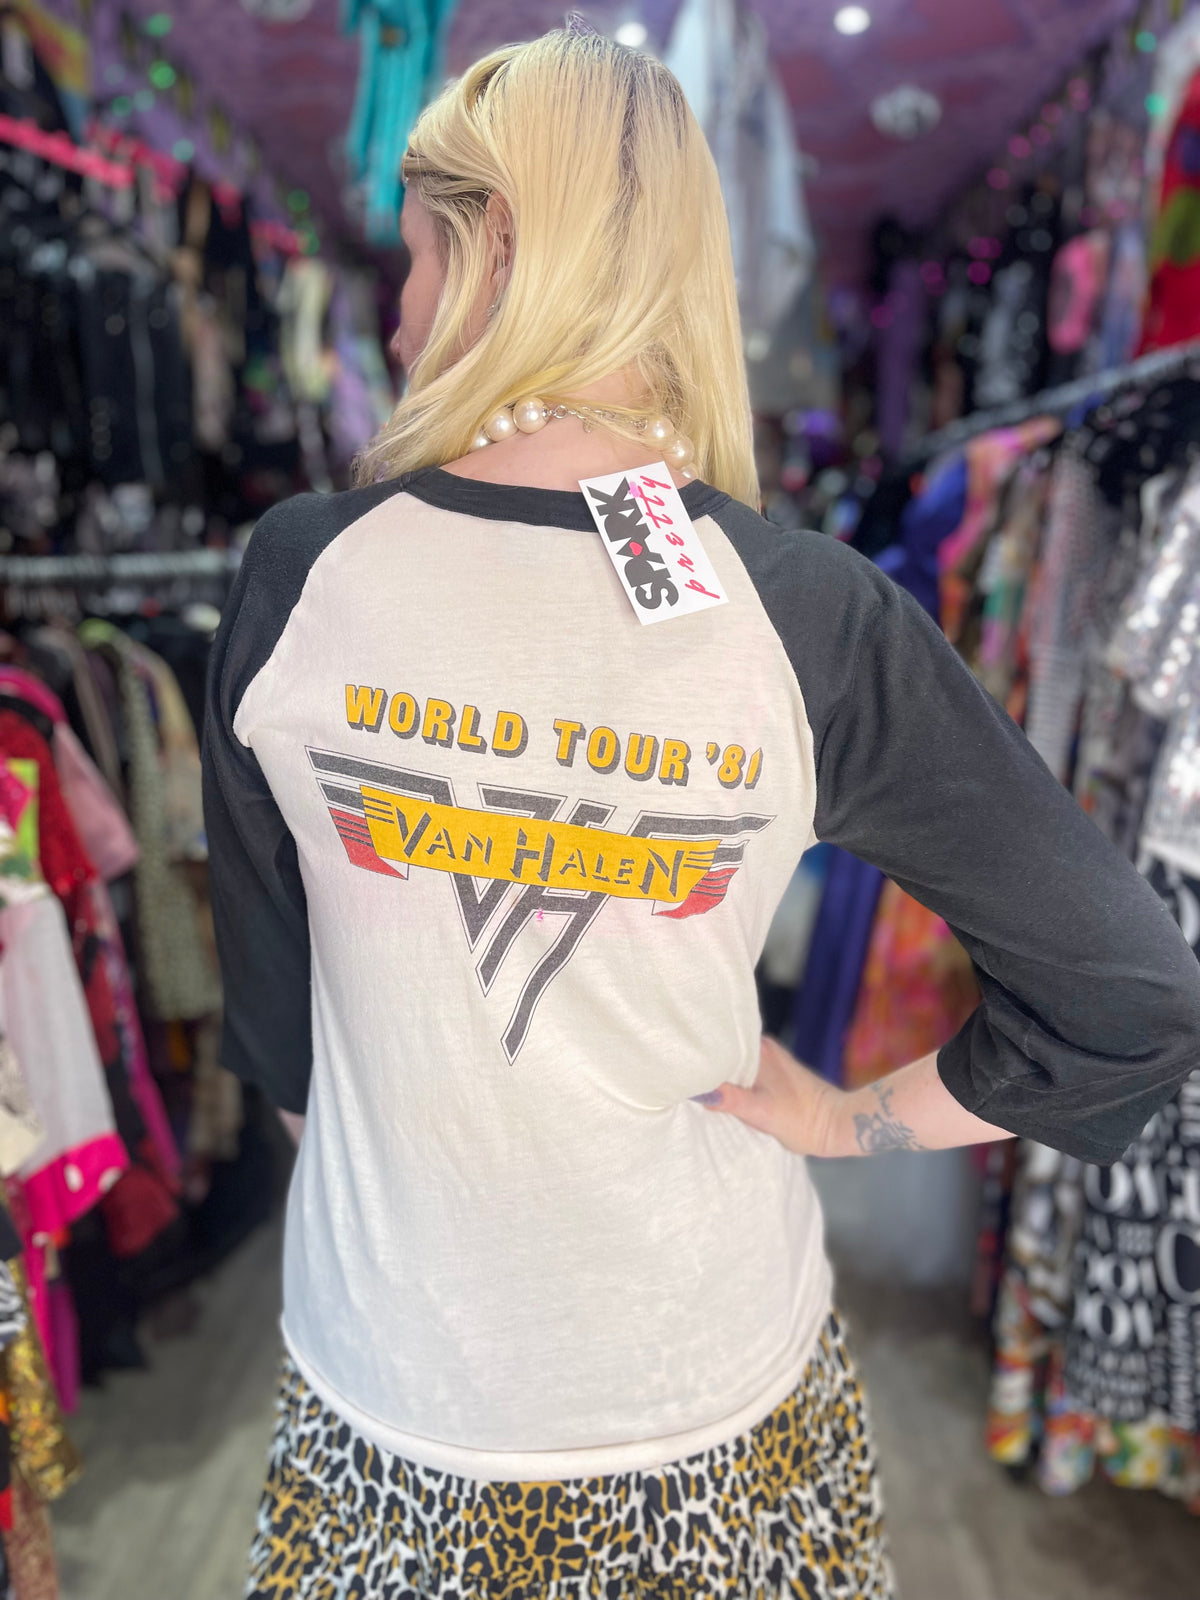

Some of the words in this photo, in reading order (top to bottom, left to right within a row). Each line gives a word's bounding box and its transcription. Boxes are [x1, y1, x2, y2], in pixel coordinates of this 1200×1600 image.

[586, 476, 679, 610] SPARK
[637, 475, 721, 600] pretty
[345, 684, 528, 758] WORLD
[553, 718, 691, 786] TOUR
[706, 742, 763, 790] '81
